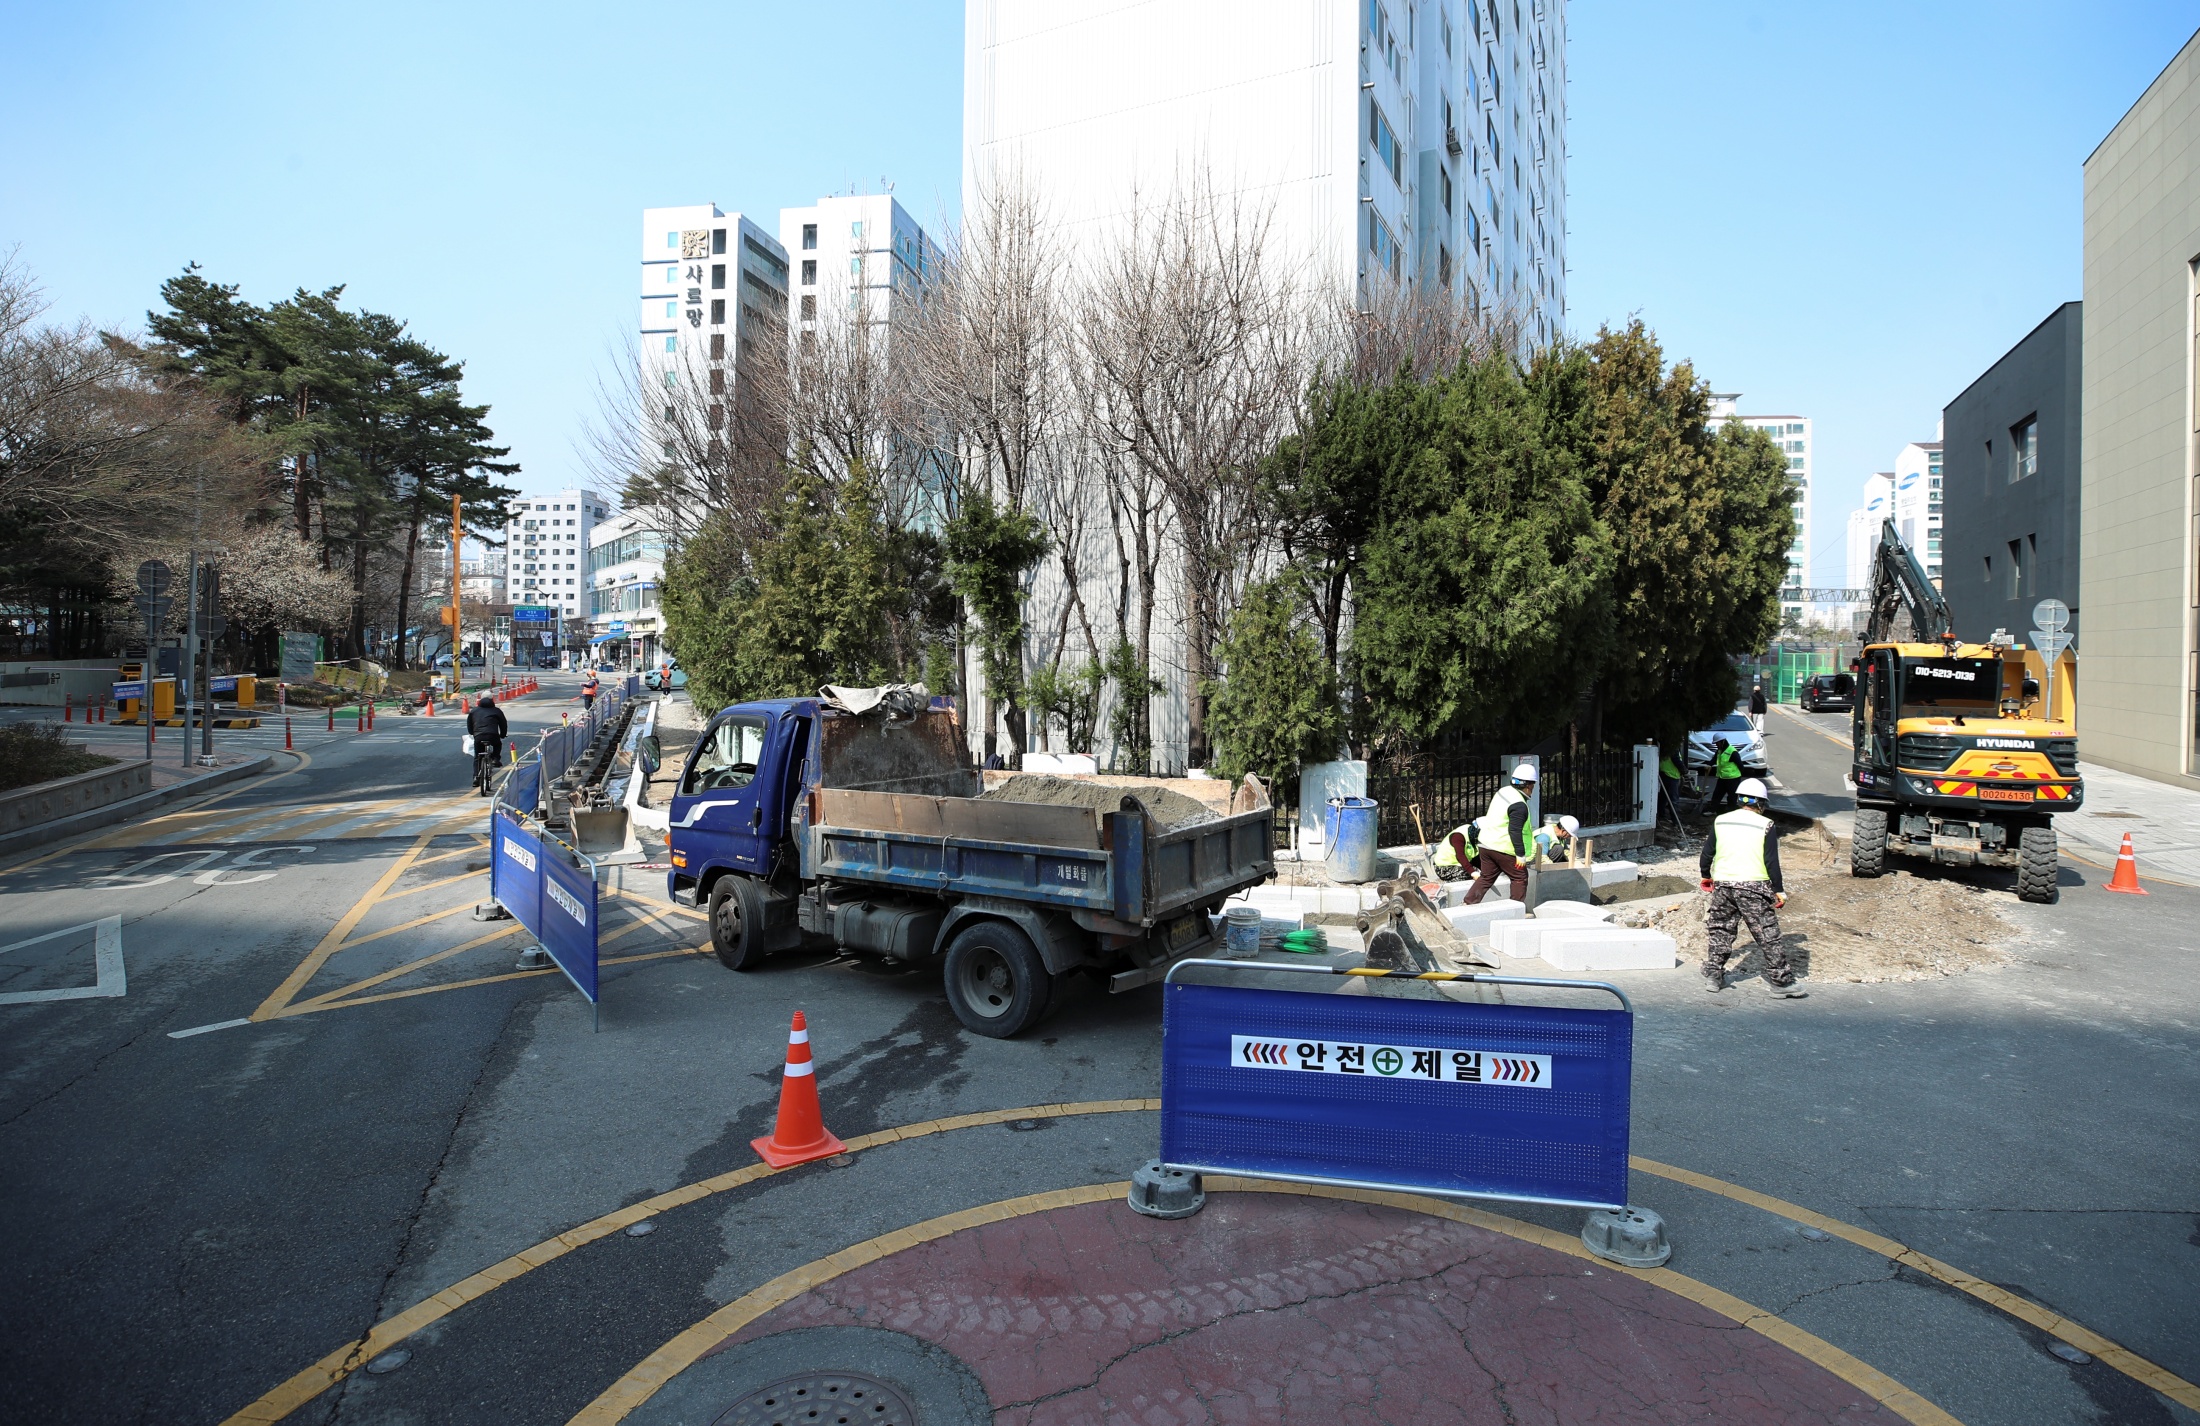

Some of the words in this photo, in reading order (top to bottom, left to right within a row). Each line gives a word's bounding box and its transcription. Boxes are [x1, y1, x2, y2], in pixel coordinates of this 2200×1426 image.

[685, 264, 705, 328] 샤르망
[1976, 738, 2035, 749] HYUNDAI
[1057, 863, 1088, 882] 개별화물
[1296, 1041, 1366, 1075] 안전
[1410, 1050, 1483, 1083] 제일
